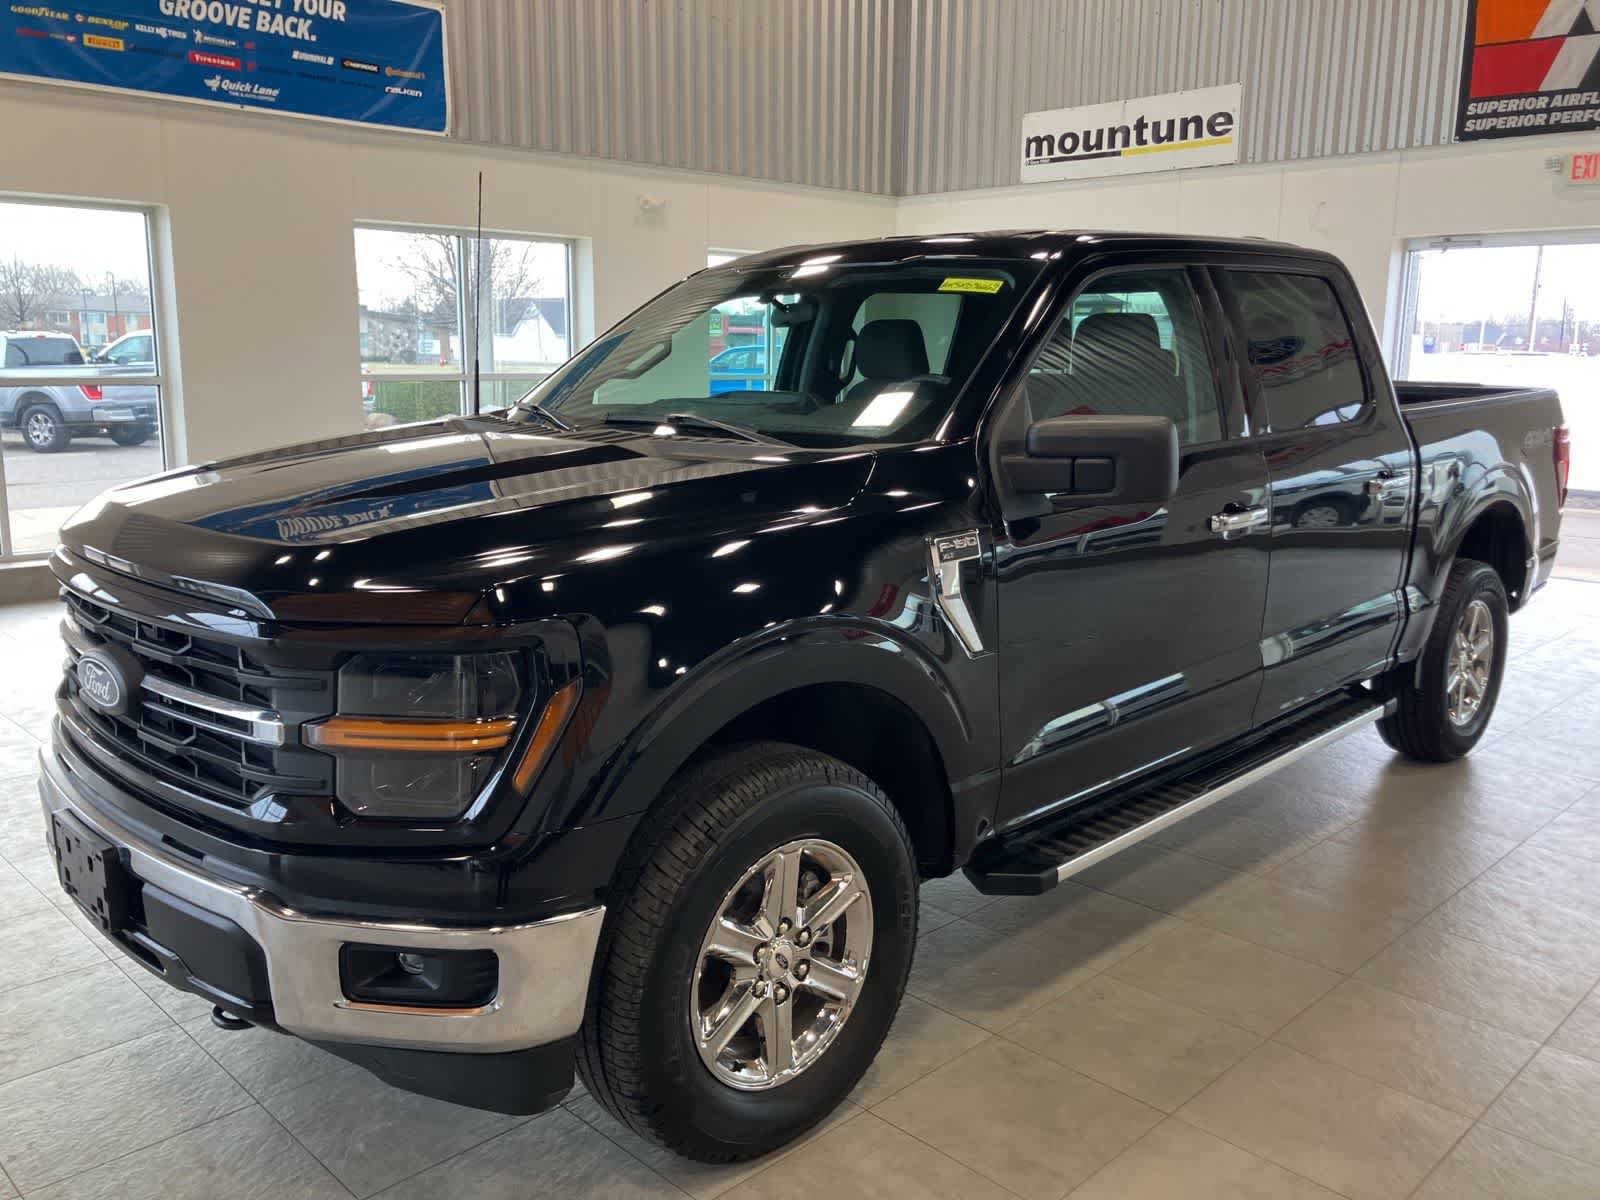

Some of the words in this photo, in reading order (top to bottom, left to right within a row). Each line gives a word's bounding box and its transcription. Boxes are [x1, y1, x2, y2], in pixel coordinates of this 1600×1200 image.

[10, 4, 70, 21] GOODYEAR
[159, 0, 252, 30] GROOVE
[256, 10, 317, 42] BACK.
[292, 0, 347, 22] YOUR
[221, 79, 252, 93] Quick
[252, 83, 280, 97] Lane
[1466, 95, 1550, 116] SUPERIOR
[1464, 113, 1548, 132] SUPERIOR
[1025, 111, 1234, 158] mountune
[84, 663, 110, 701] Ford
